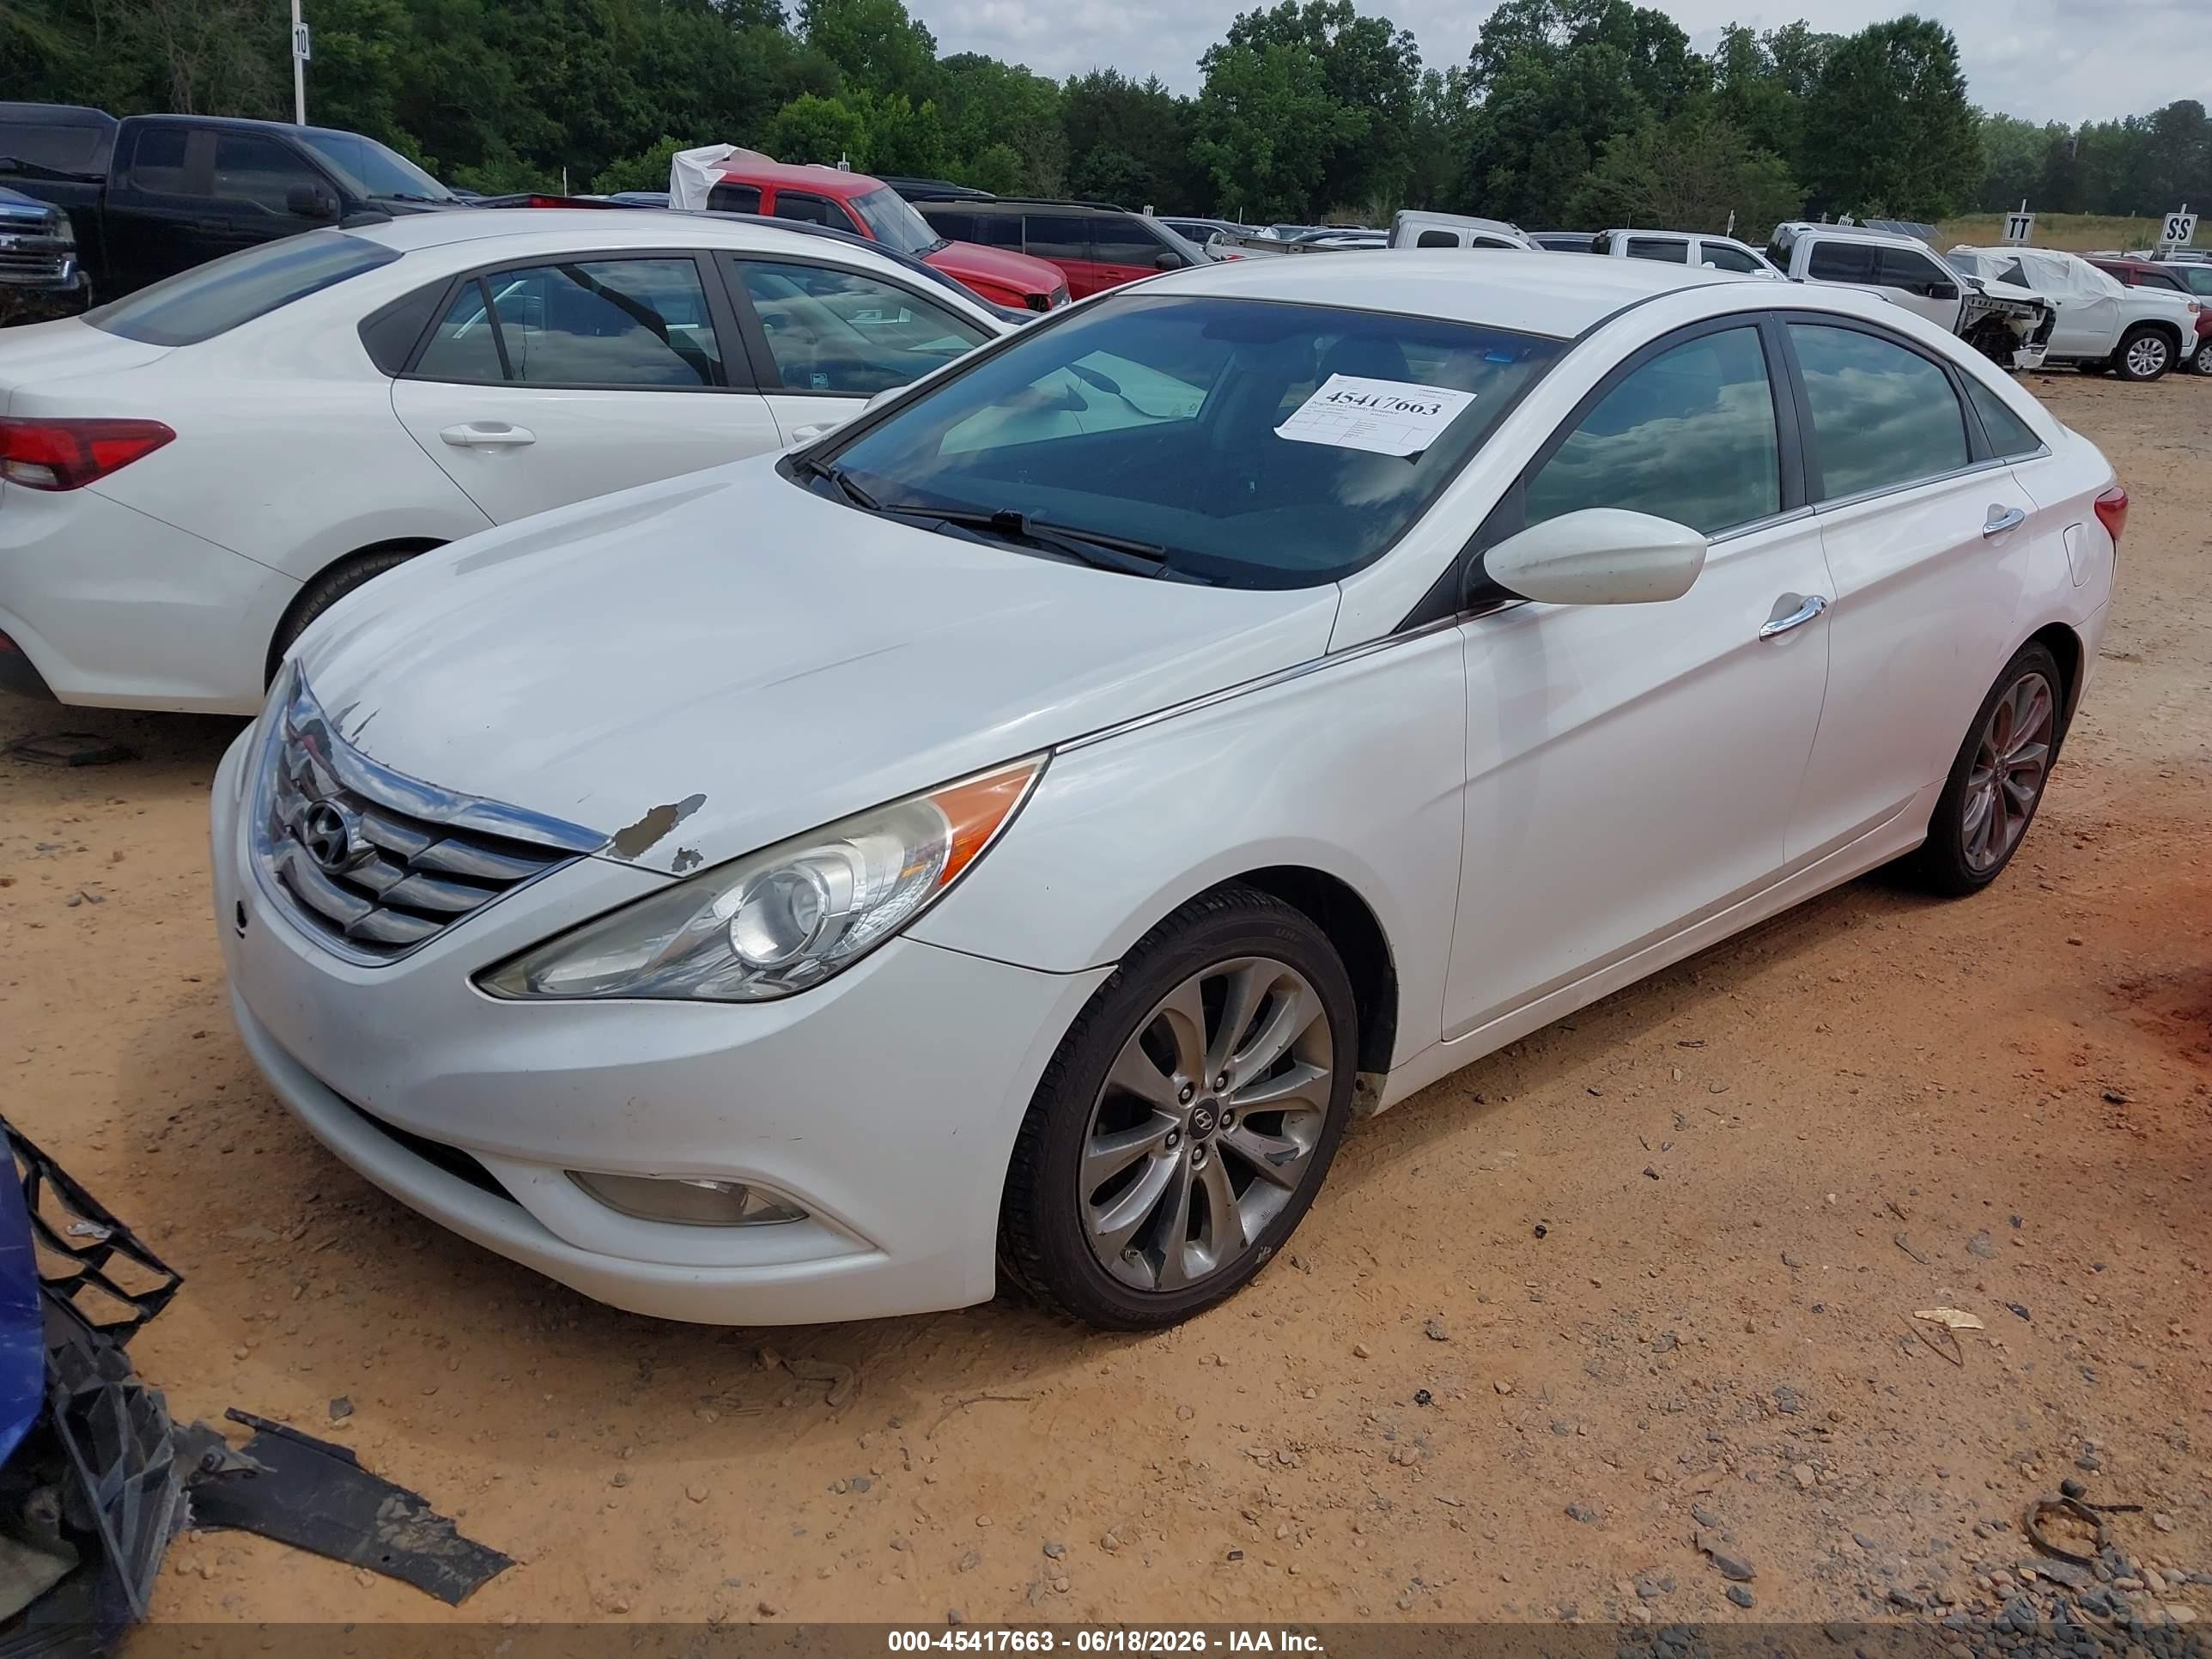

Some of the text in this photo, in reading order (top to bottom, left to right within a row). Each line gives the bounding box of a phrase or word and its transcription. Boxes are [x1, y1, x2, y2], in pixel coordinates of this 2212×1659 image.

[295, 27, 307, 53] 10
[2009, 217, 2030, 239] TT
[2166, 217, 2191, 240] SS
[1325, 391, 1442, 416] 45417663
